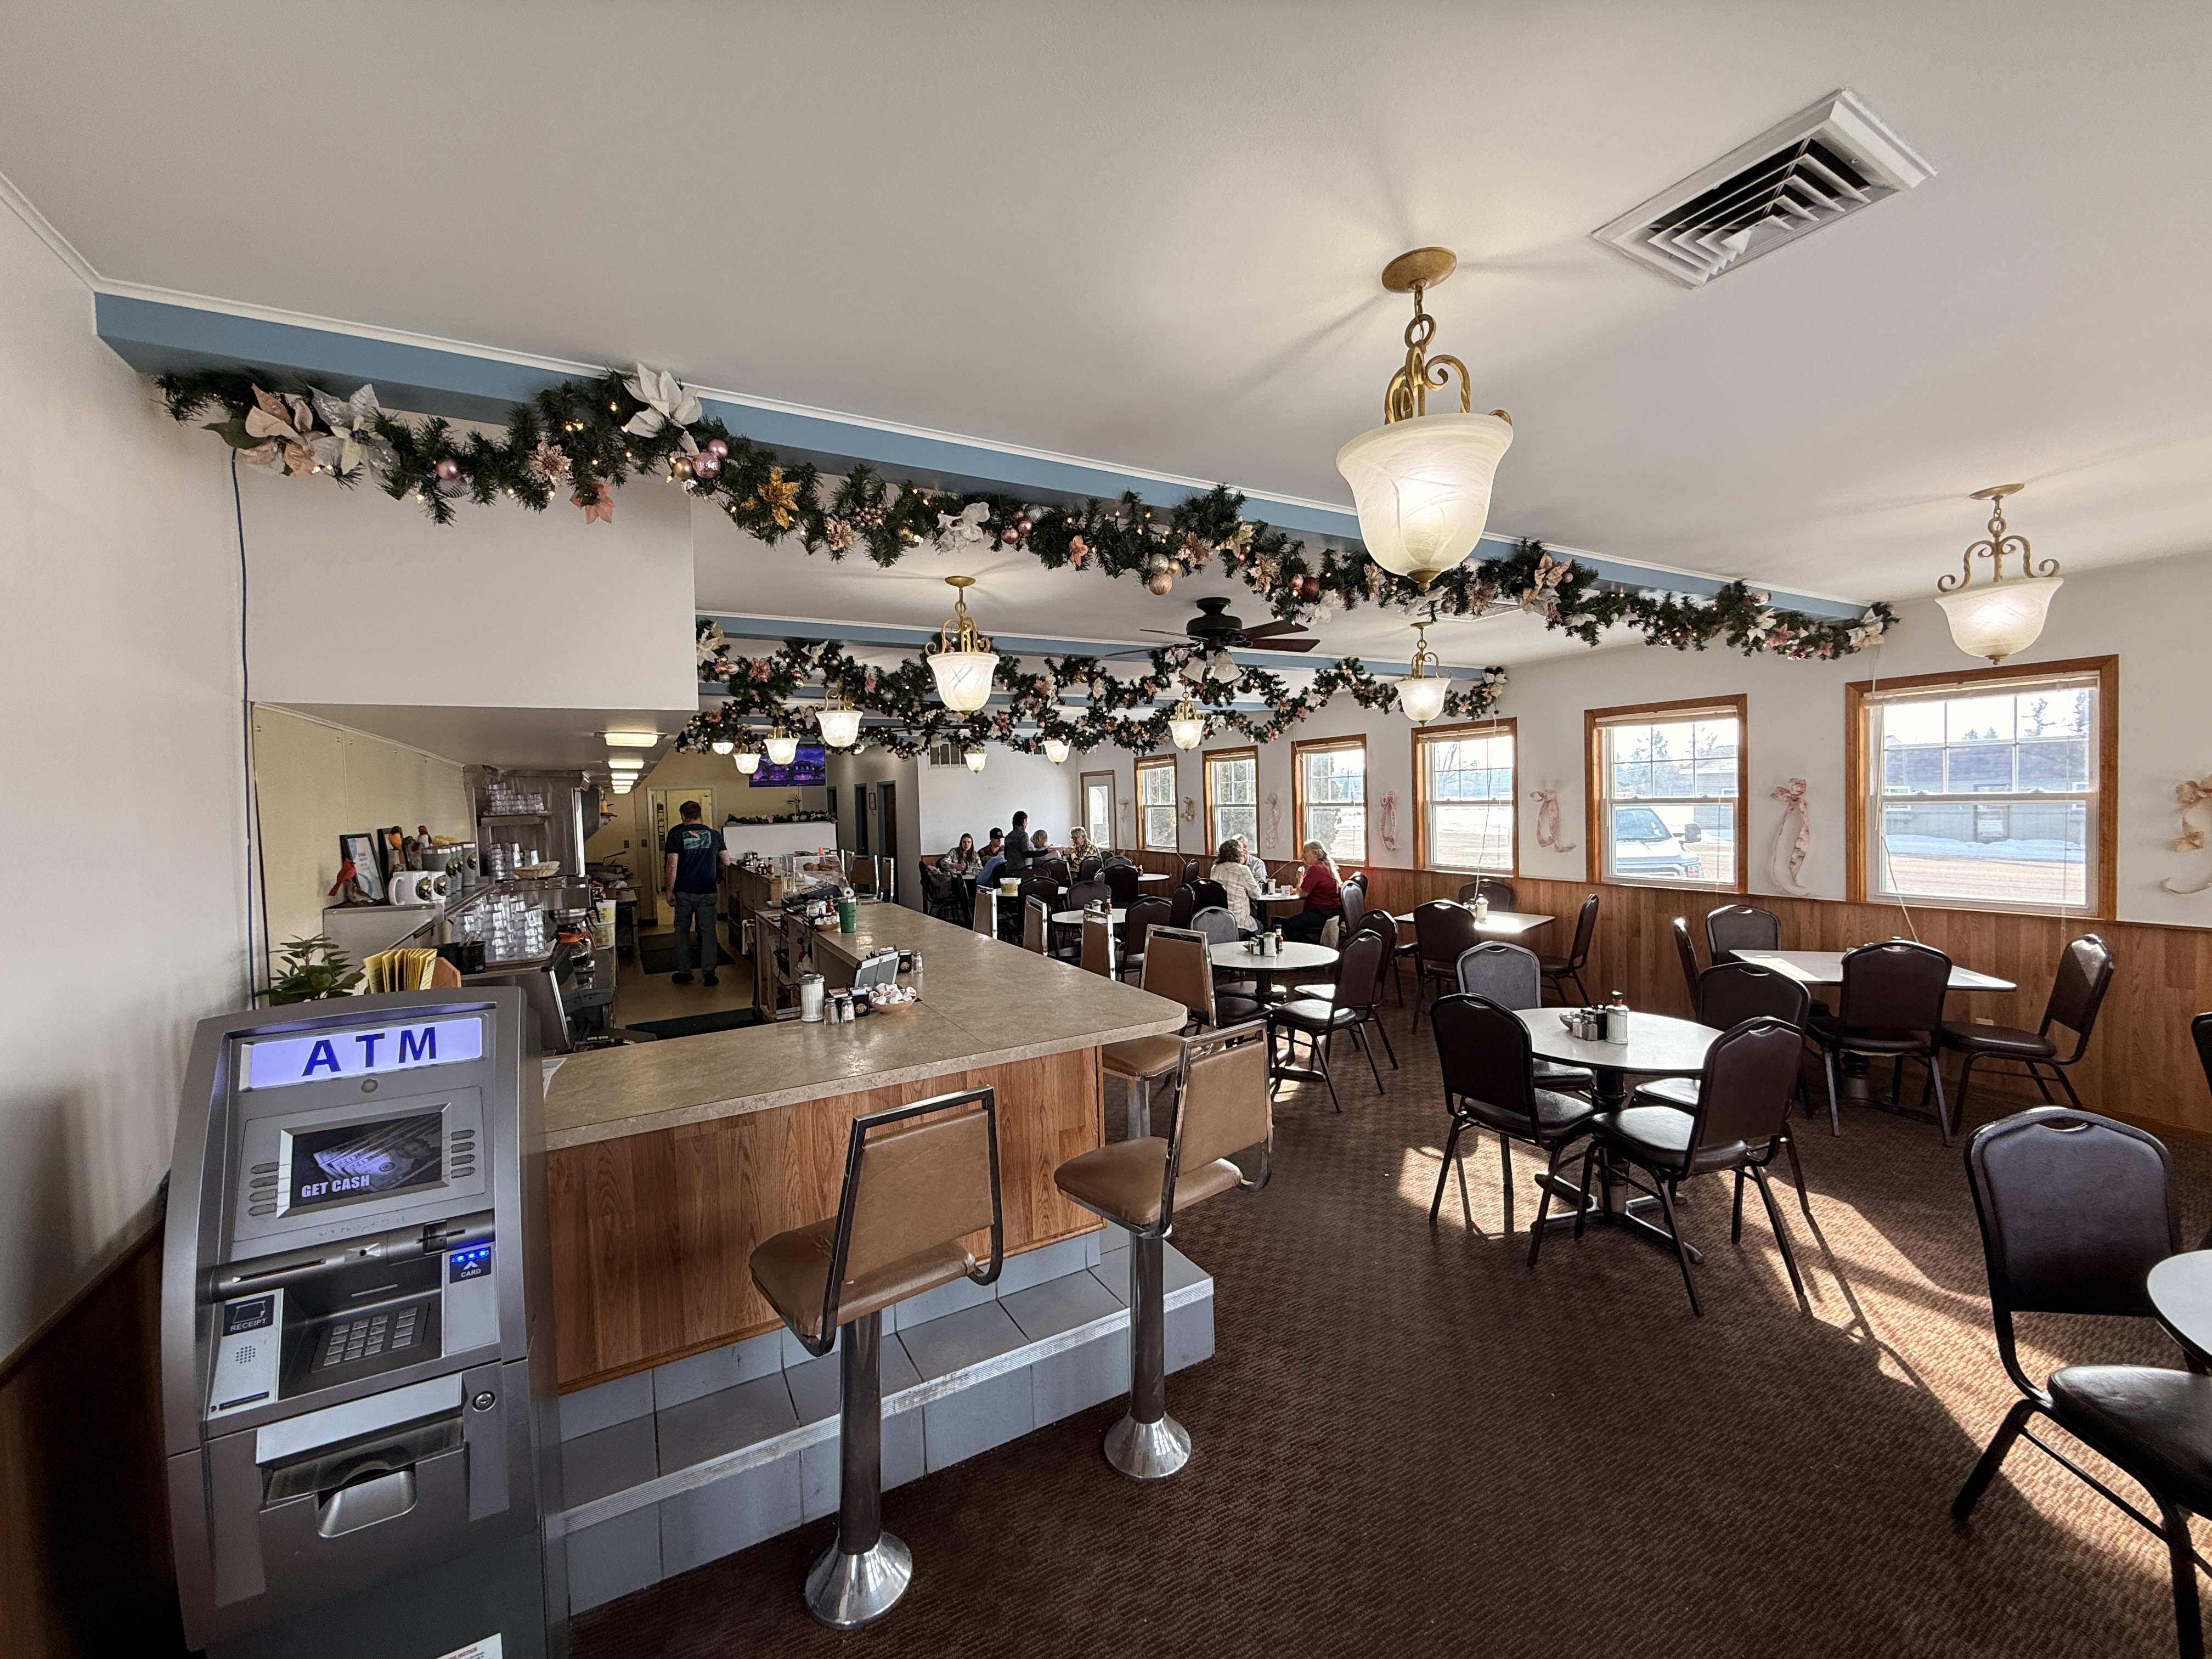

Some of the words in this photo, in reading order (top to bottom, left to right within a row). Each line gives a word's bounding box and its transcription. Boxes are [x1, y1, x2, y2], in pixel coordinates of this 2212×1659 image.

[302, 1026, 437, 1076] ATM
[301, 1181, 329, 1198] GET
[331, 1175, 370, 1193] CASH
[461, 1268, 482, 1278] CARD
[230, 1318, 267, 1331] RECEIPT
